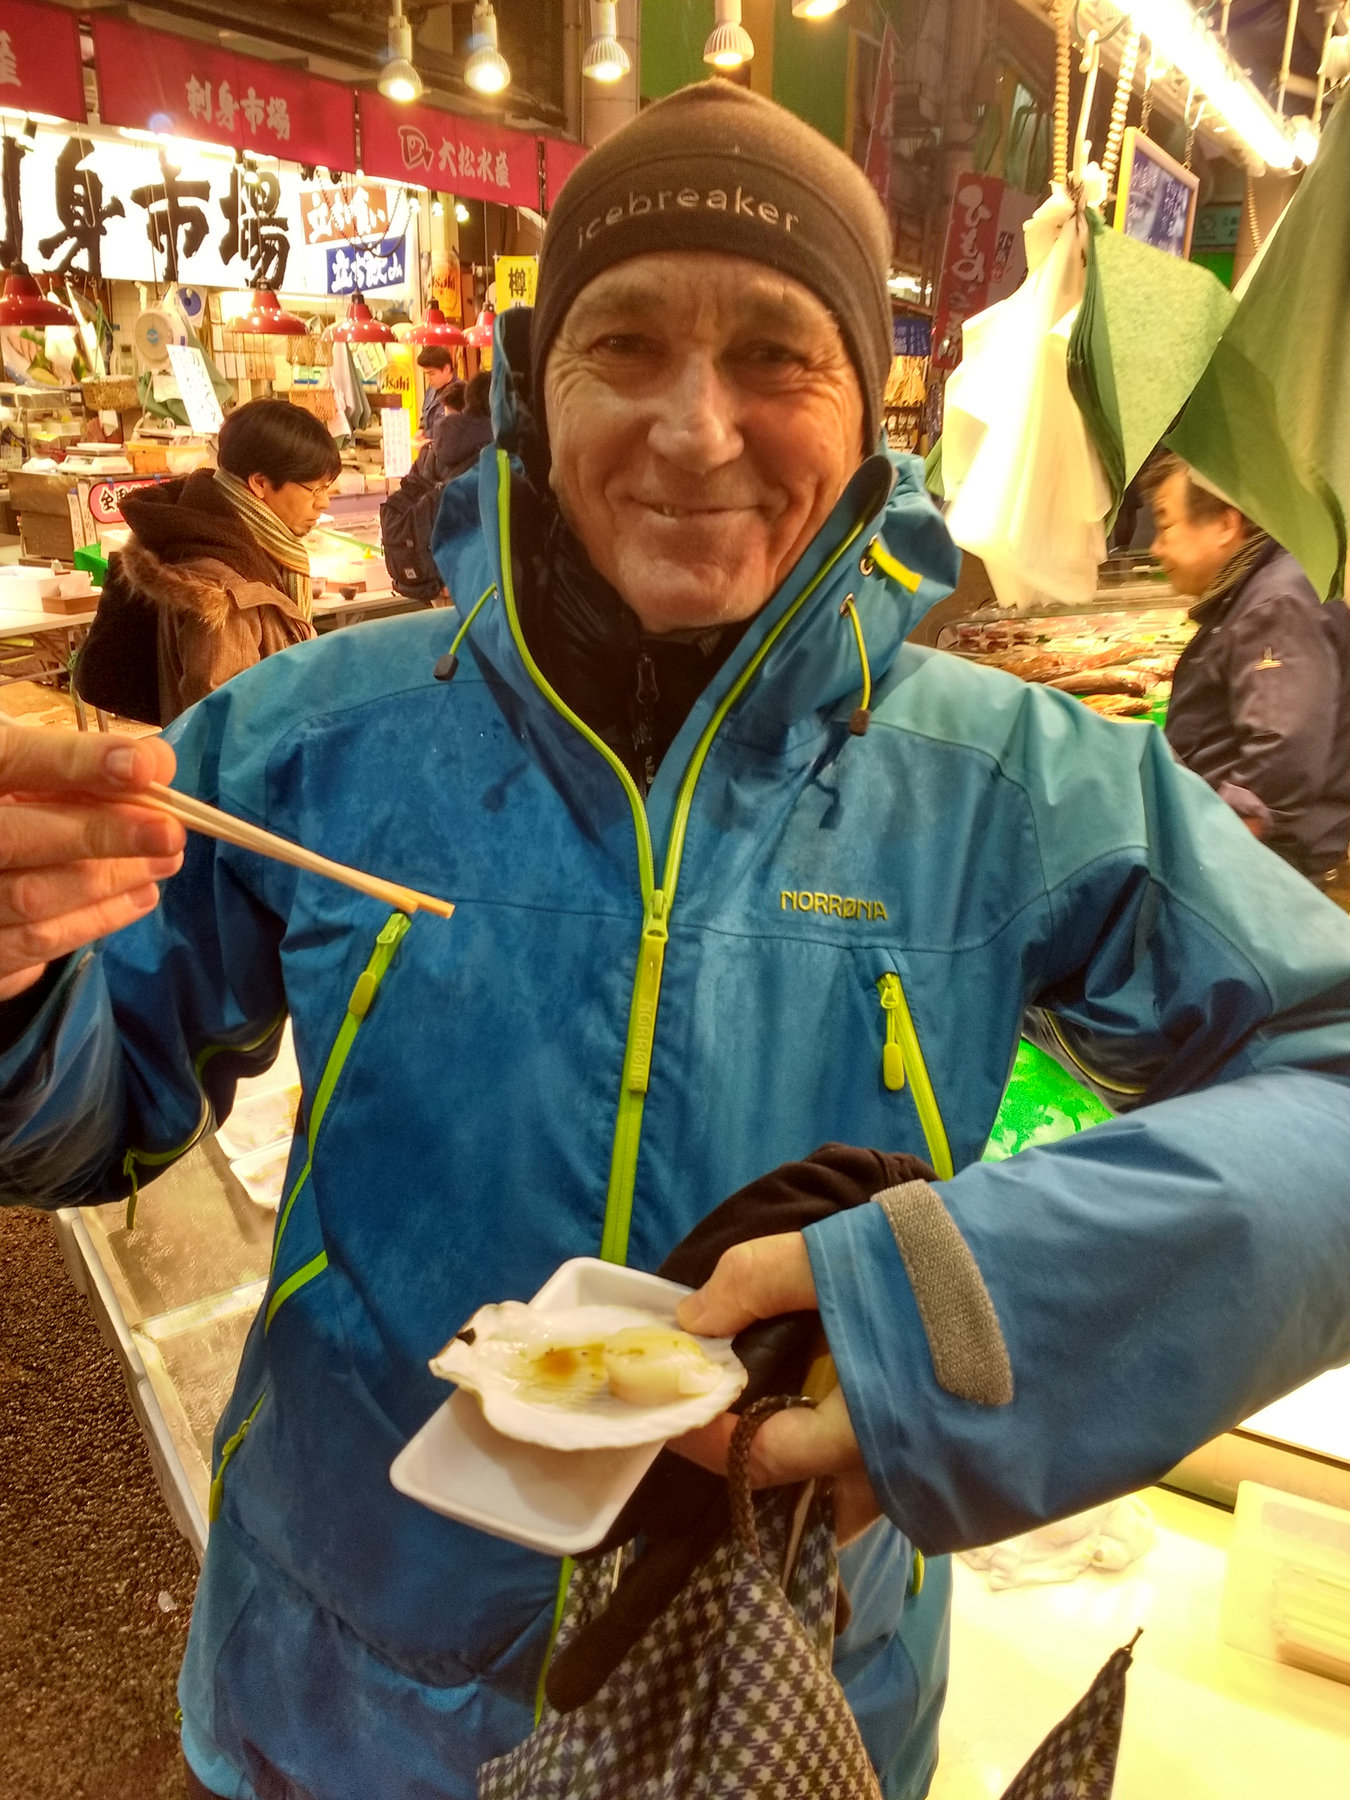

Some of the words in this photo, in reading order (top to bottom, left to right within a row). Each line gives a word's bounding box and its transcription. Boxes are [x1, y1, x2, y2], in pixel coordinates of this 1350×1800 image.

[184, 73, 290, 141] 刺身市場
[780, 889, 889, 921] NORRØNA
